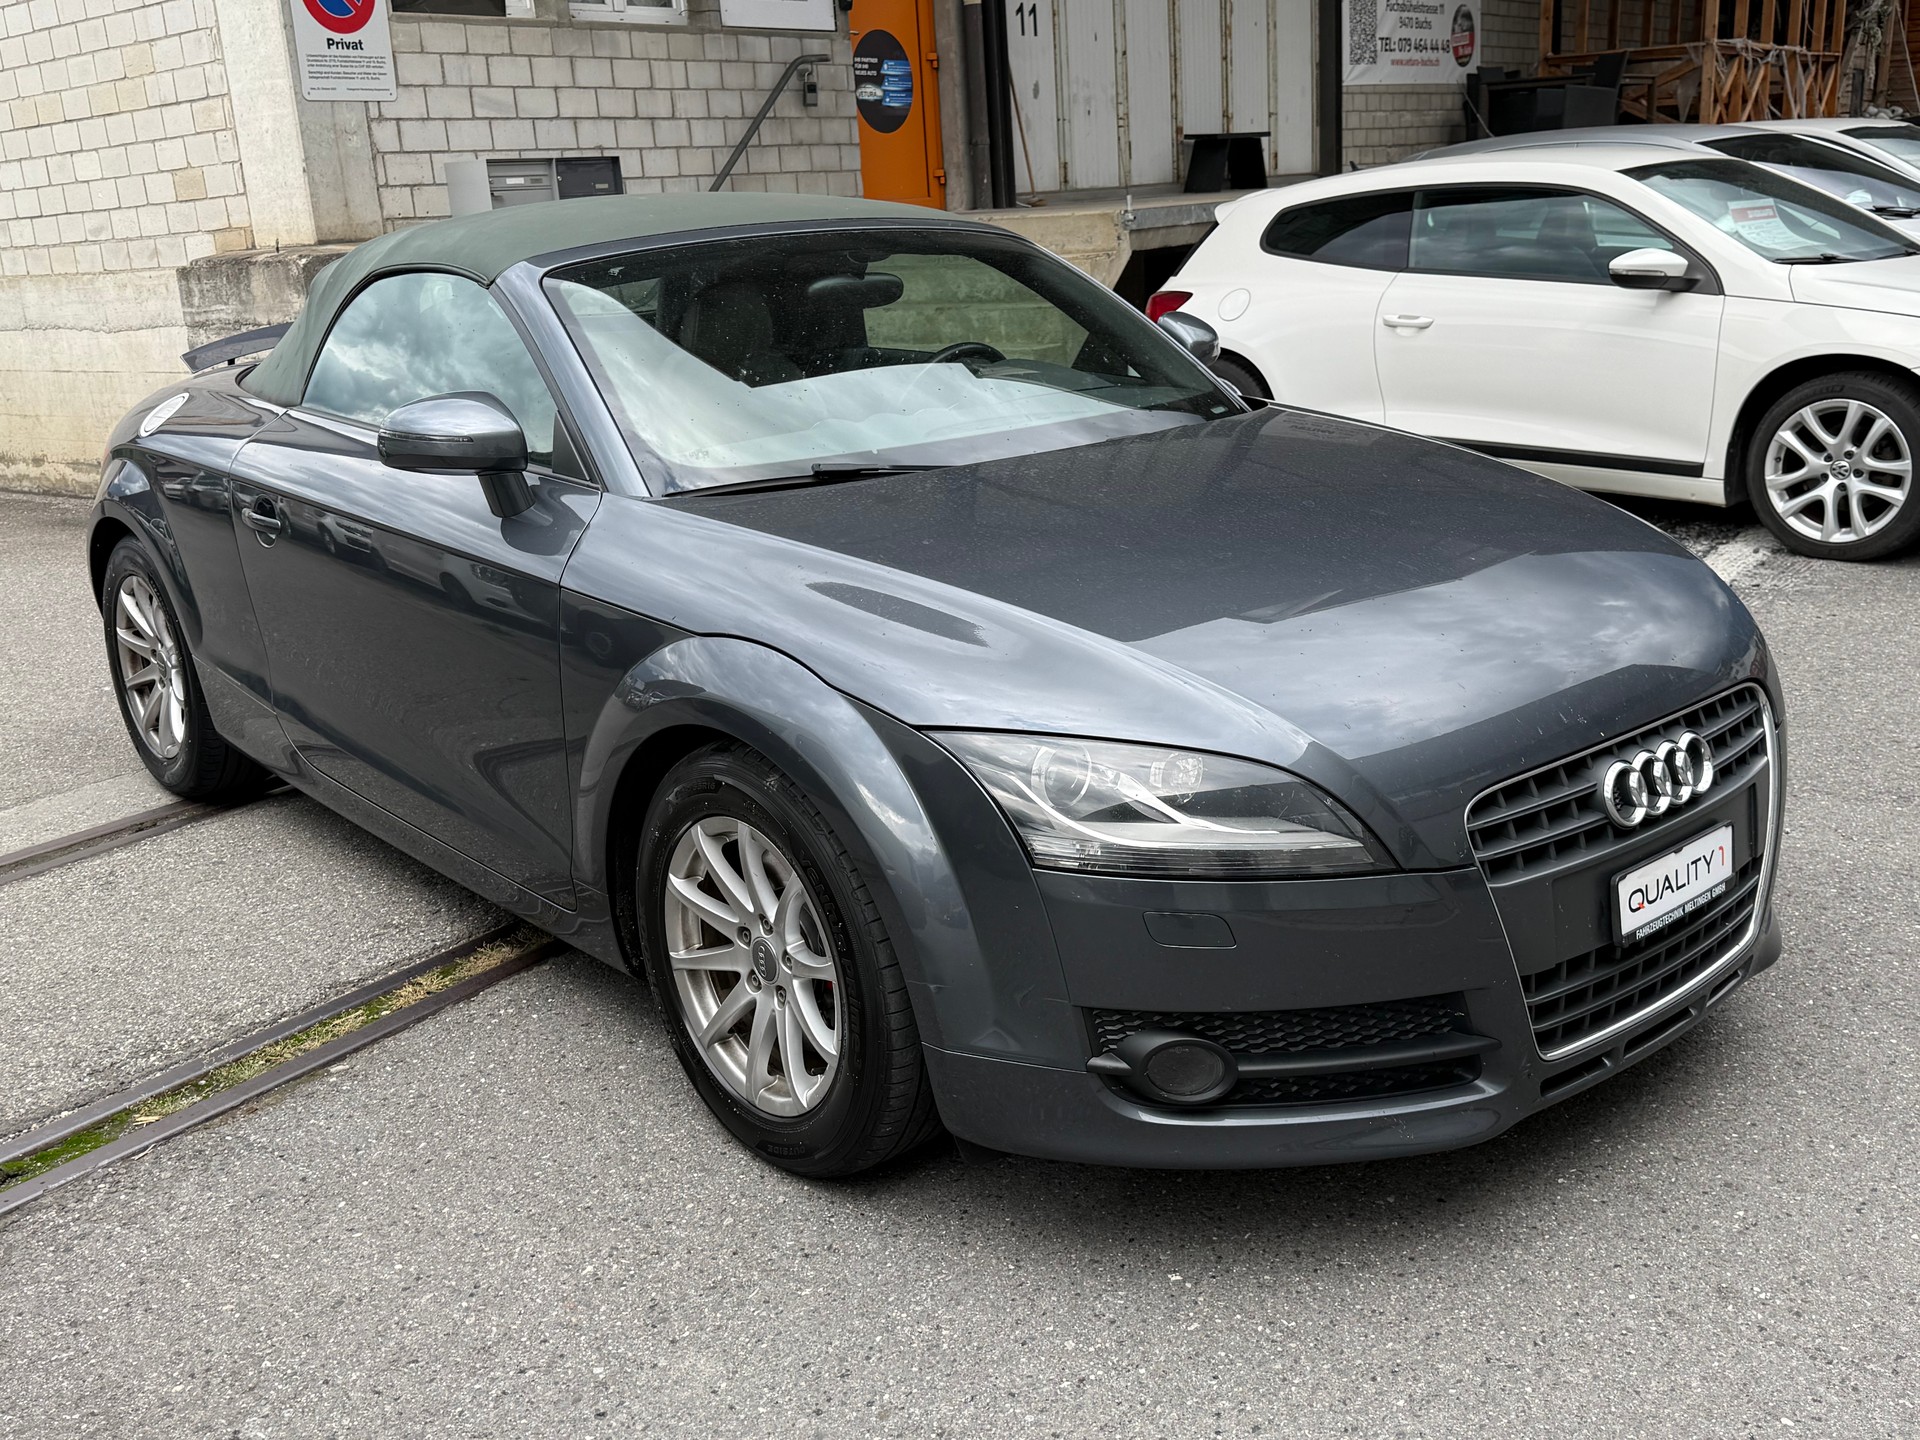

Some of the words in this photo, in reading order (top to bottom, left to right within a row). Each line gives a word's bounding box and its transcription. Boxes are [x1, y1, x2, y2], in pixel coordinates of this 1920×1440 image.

[1015, 2, 1038, 37] 11
[1399, 17, 1414, 29] 9470
[1415, 18, 1432, 30] Buchs
[326, 37, 364, 51] Privat
[1379, 37, 1396, 53] TEL:
[1397, 38, 1412, 53] 079
[1413, 38, 1428, 53] 464
[1429, 39, 1440, 53] 44
[1628, 849, 1715, 913] QUALITY
[1718, 845, 1725, 866] 1
[1636, 905, 1684, 940] FAHRZEUGTECHNIK
[1684, 892, 1711, 914] MELTINGEN
